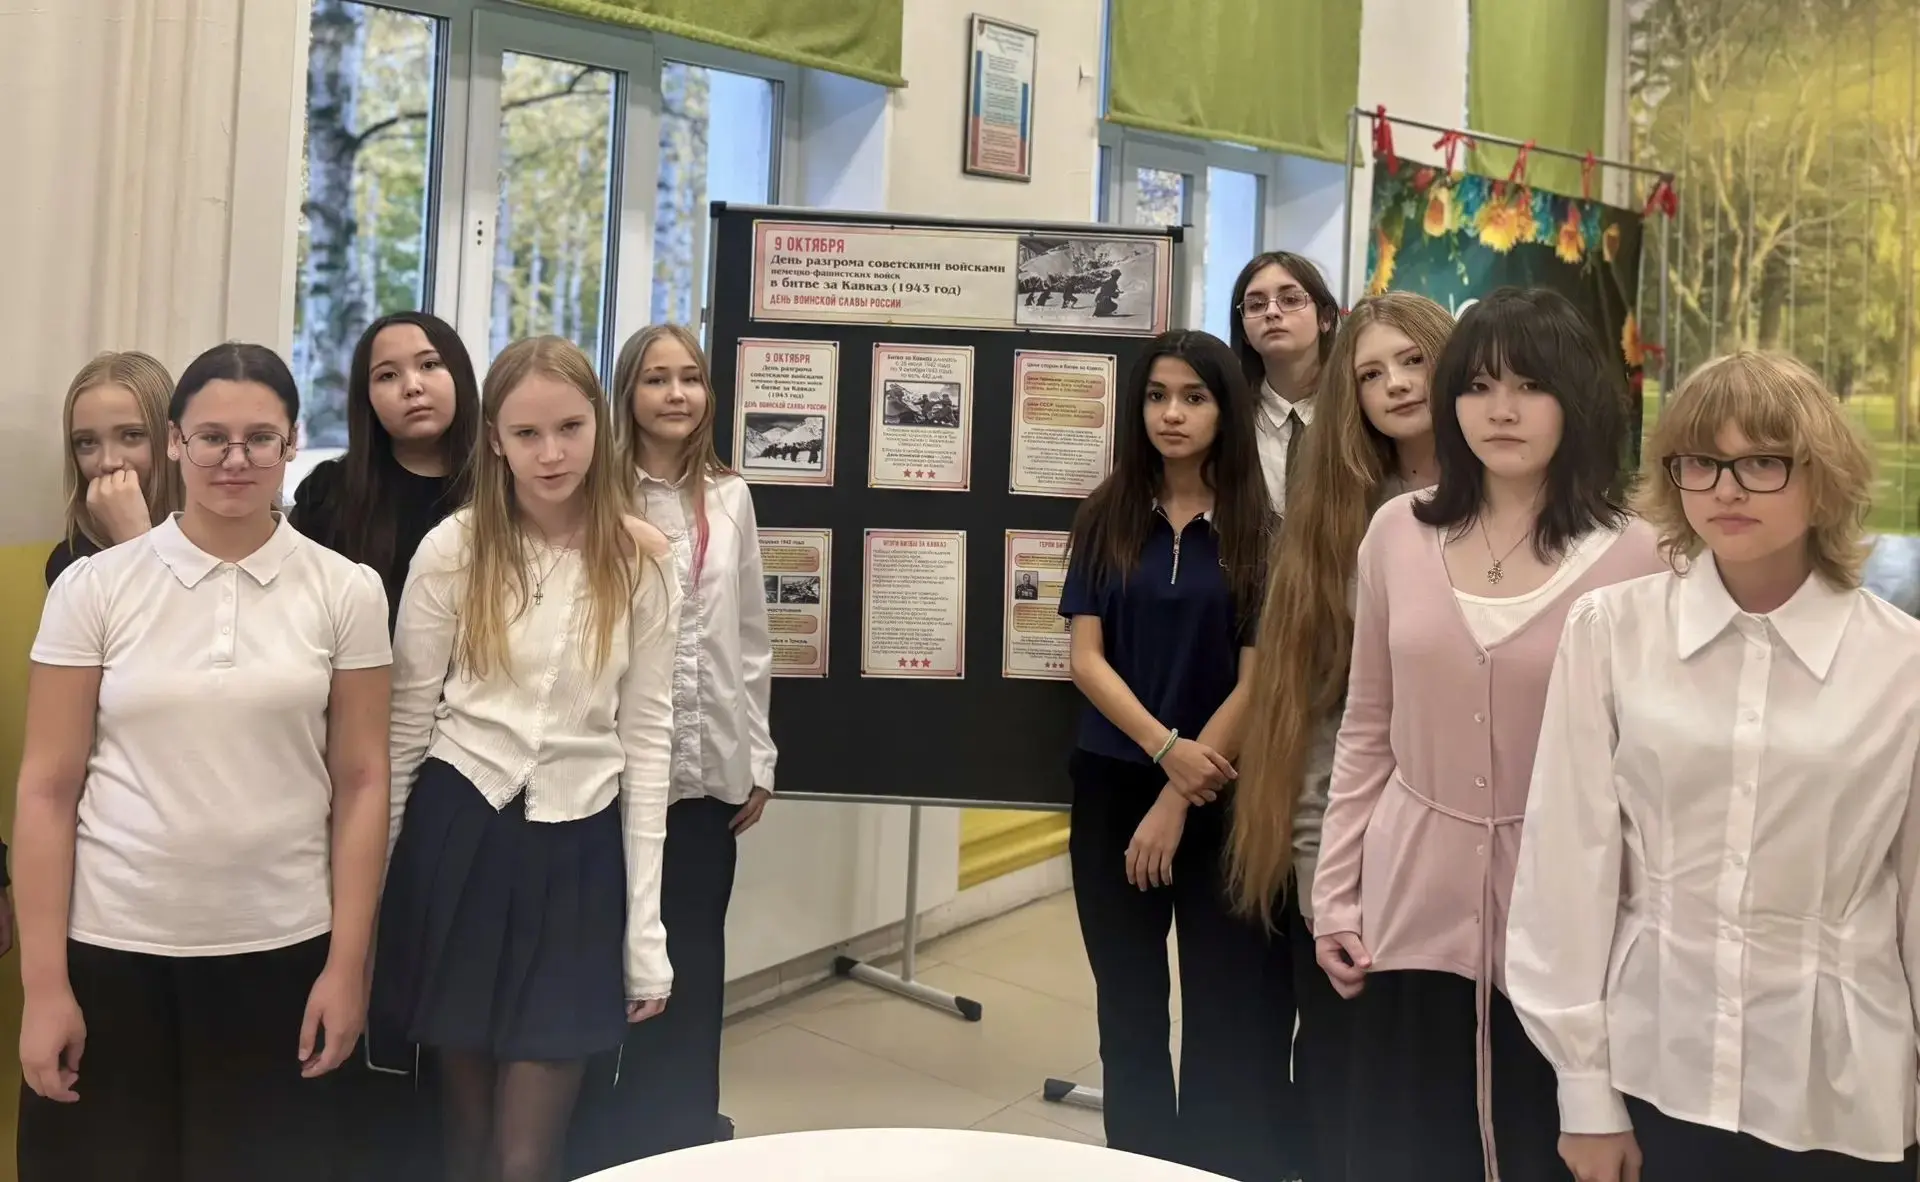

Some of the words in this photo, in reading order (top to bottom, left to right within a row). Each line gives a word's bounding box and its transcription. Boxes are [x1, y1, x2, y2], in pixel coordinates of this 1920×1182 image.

[775, 236, 782, 251] 9
[787, 236, 845, 253] ОКТЯБРЯ
[770, 255, 802, 265] День
[806, 257, 864, 269] разгрома
[868, 259, 940, 271] советскими
[945, 262, 1006, 273] войсками
[771, 268, 871, 279] немецко-фашистских
[874, 271, 901, 280] войск
[782, 278, 819, 289] битве
[823, 281, 838, 290] за
[842, 281, 888, 292] Кавказ
[892, 282, 930, 294] (1943
[934, 285, 962, 296] год)
[770, 294, 791, 305] ДЕНЬ
[794, 294, 836, 306] ВОИНСКОЙ
[838, 297, 868, 307] СЛАВЫ
[870, 298, 902, 309] РОССИИ
[765, 352, 770, 362] 9
[773, 353, 811, 364] ОКТЯБРЯ
[744, 401, 757, 409] ДЕНЬ
[759, 401, 785, 410] ВОИНСКОЙ
[787, 402, 805, 410] СЛАВЫ
[806, 403, 827, 411] РОССИИ
